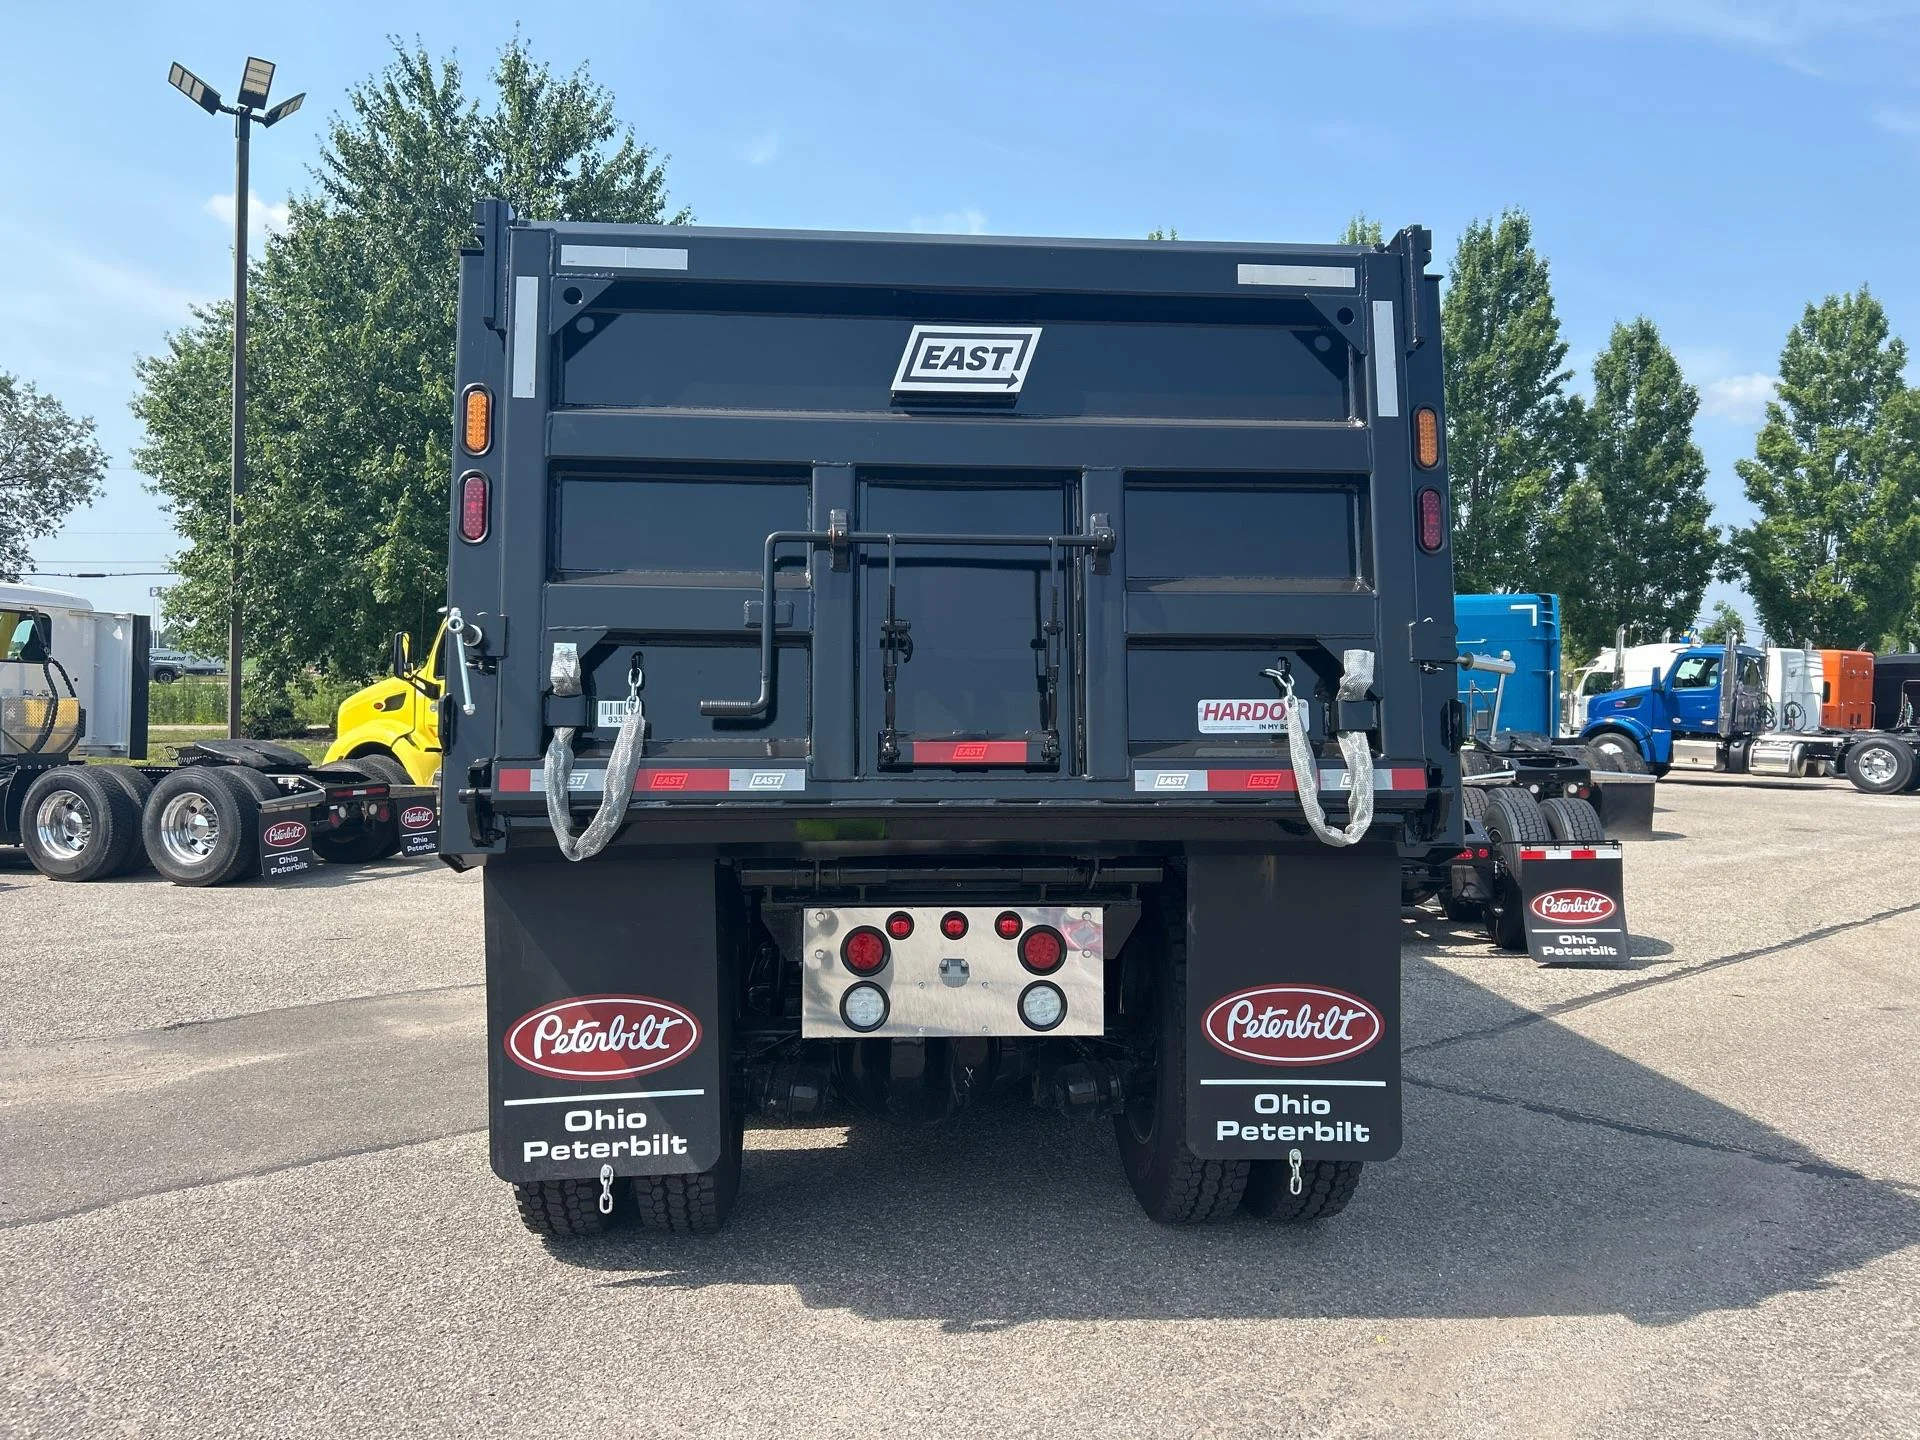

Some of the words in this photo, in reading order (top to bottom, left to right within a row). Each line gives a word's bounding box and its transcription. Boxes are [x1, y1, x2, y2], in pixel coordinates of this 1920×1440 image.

[919, 345, 1014, 371] EAST
[1203, 702, 1289, 721] HARDO
[958, 747, 983, 756] EAST
[656, 776, 684, 785] EAST
[755, 776, 781, 785] EAST
[1159, 776, 1183, 785] EAST
[1252, 776, 1277, 785] EAST
[269, 825, 303, 842] Peterbilt
[412, 836, 428, 844] Ohio
[279, 856, 298, 865] Ohio
[270, 862, 308, 875] Peterbilt
[1541, 895, 1608, 914] Peterbilt
[1559, 935, 1597, 945] Ohio
[1542, 946, 1618, 956] Peterbilt
[1226, 999, 1366, 1042] Peterbilt
[533, 1013, 684, 1060] Peterbilt
[1254, 1093, 1331, 1115] Ohio
[564, 1107, 647, 1132] Ohio
[1216, 1120, 1370, 1143] Peterbilt
[523, 1133, 688, 1163] Peterbilt
